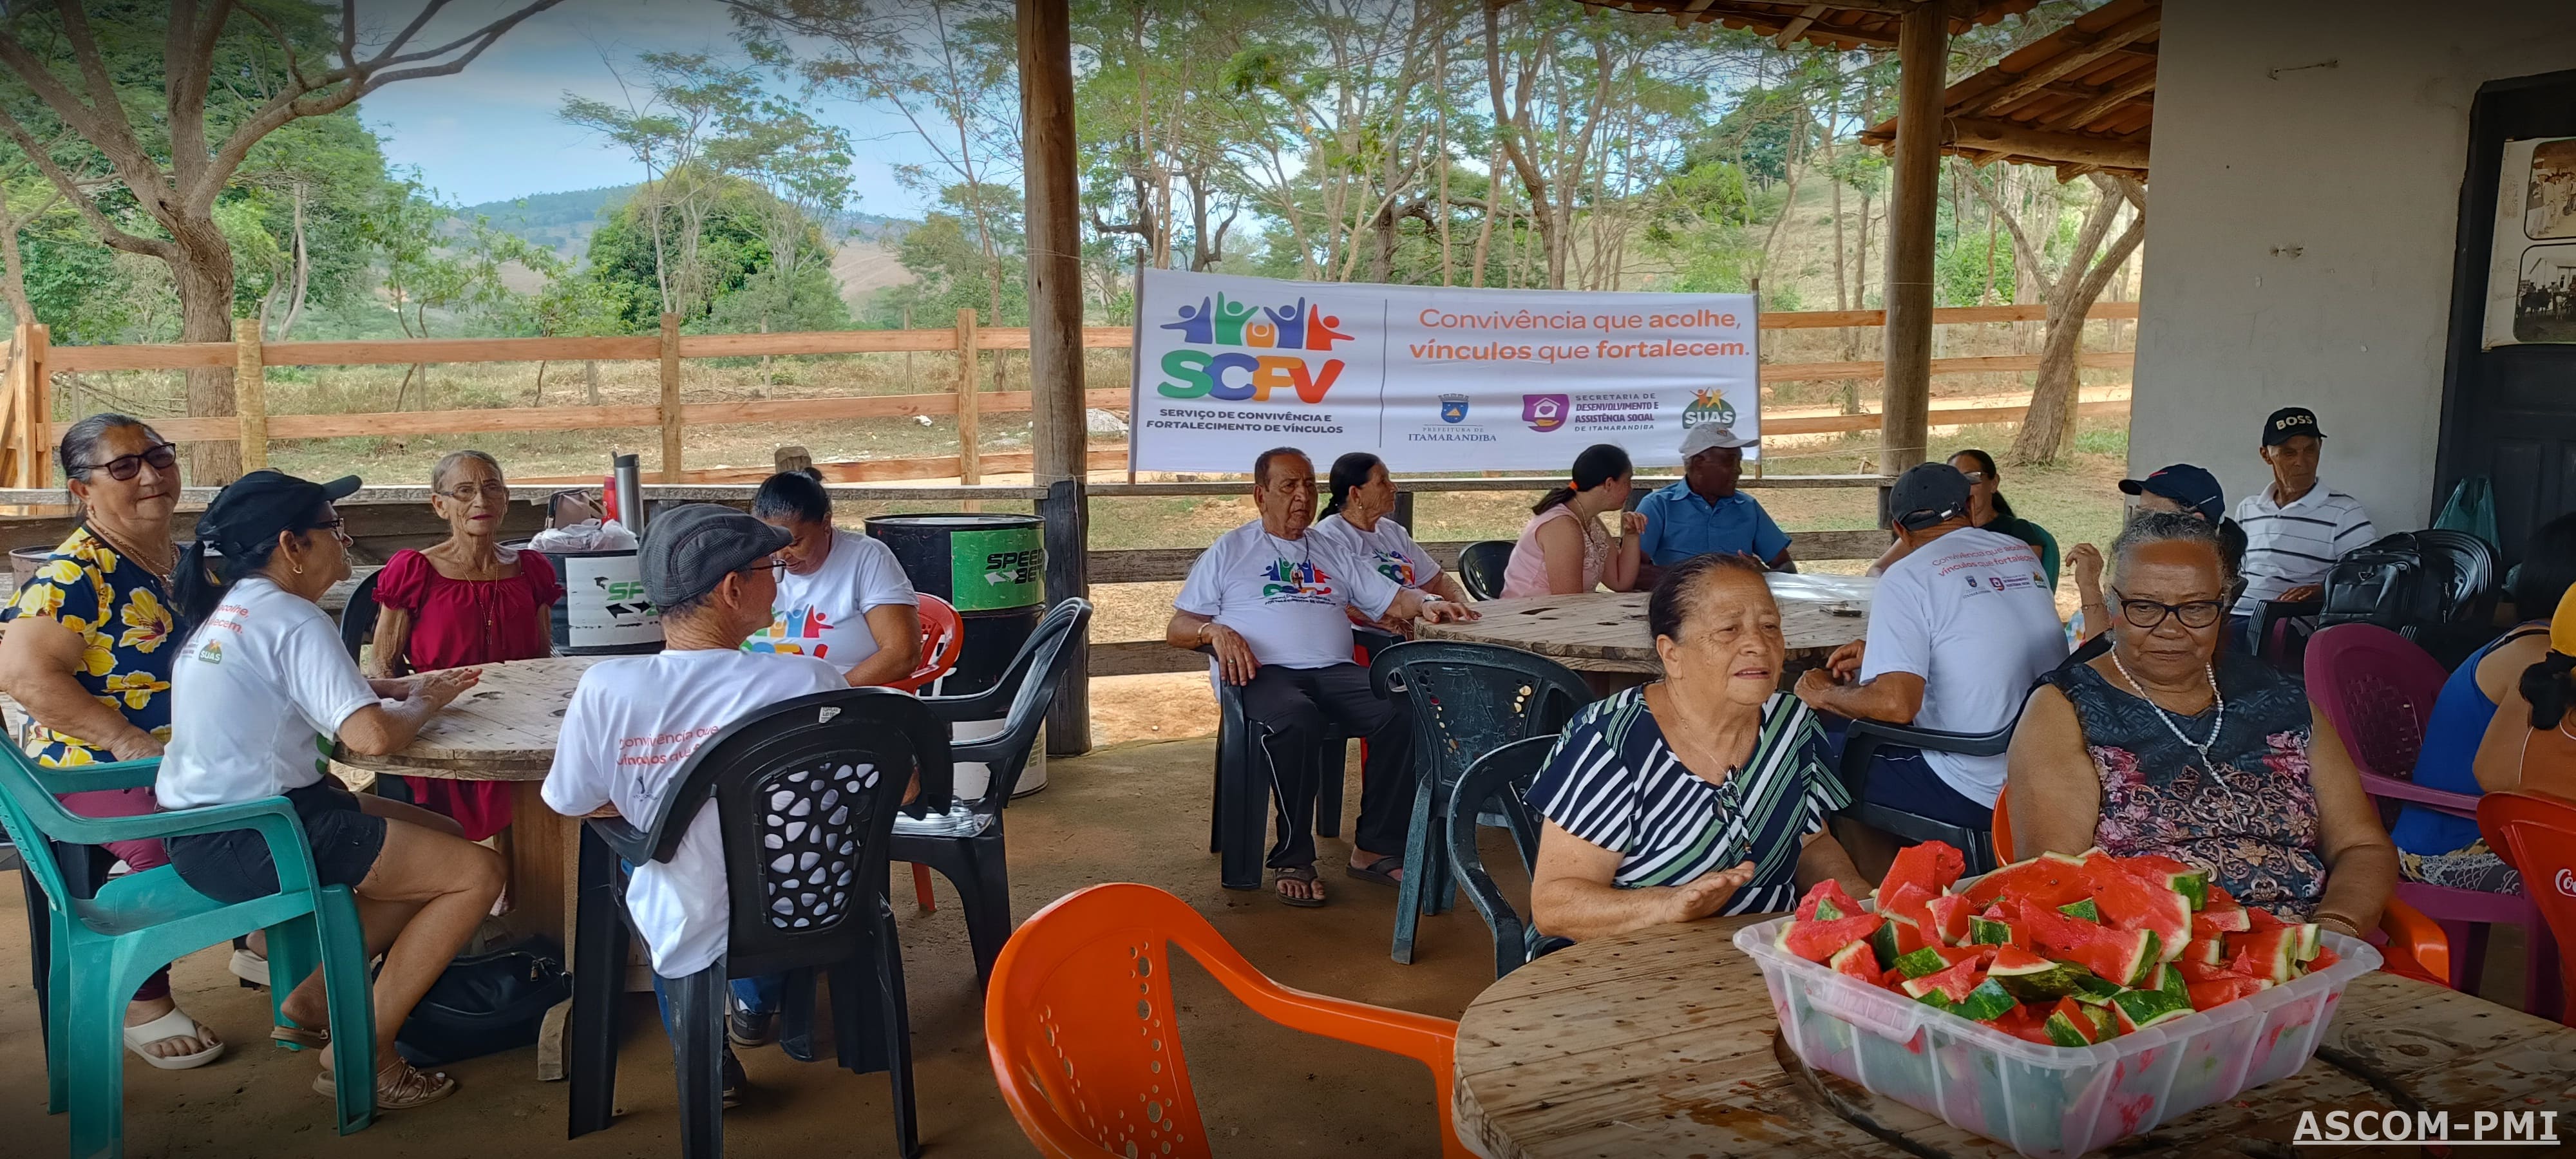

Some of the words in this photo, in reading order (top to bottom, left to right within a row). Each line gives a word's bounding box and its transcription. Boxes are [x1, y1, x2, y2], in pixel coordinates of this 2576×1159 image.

[1419, 308, 1586, 330] Convivência
[1593, 314, 1642, 333] que
[1649, 309, 1741, 330] acolhe,
[1409, 338, 1531, 360] vínculos
[1538, 345, 1590, 364] que
[1596, 339, 1750, 359] fortalecem.
[1157, 349, 1345, 404] SCFV
[1576, 402, 1652, 411] DESENVOLVIMENTO
[1160, 408, 1215, 420] SERVIÇO
[1218, 410, 1235, 419] DE
[1237, 410, 1323, 422] CONVIVÊNCIA
[1575, 413, 1625, 423] ASSISTÊNCIA
[1627, 413, 1654, 422] SOCIAL
[1685, 411, 1733, 424] SUAS
[1146, 420, 1262, 432] FORTALECIMENTO
[1264, 424, 1281, 432] DE
[1283, 422, 1343, 433] VÍNCULOS
[2276, 415, 2313, 430] BOSS
[1408, 433, 1497, 442] ITAMARANDIBA
[200, 650, 220, 661] SUAS
